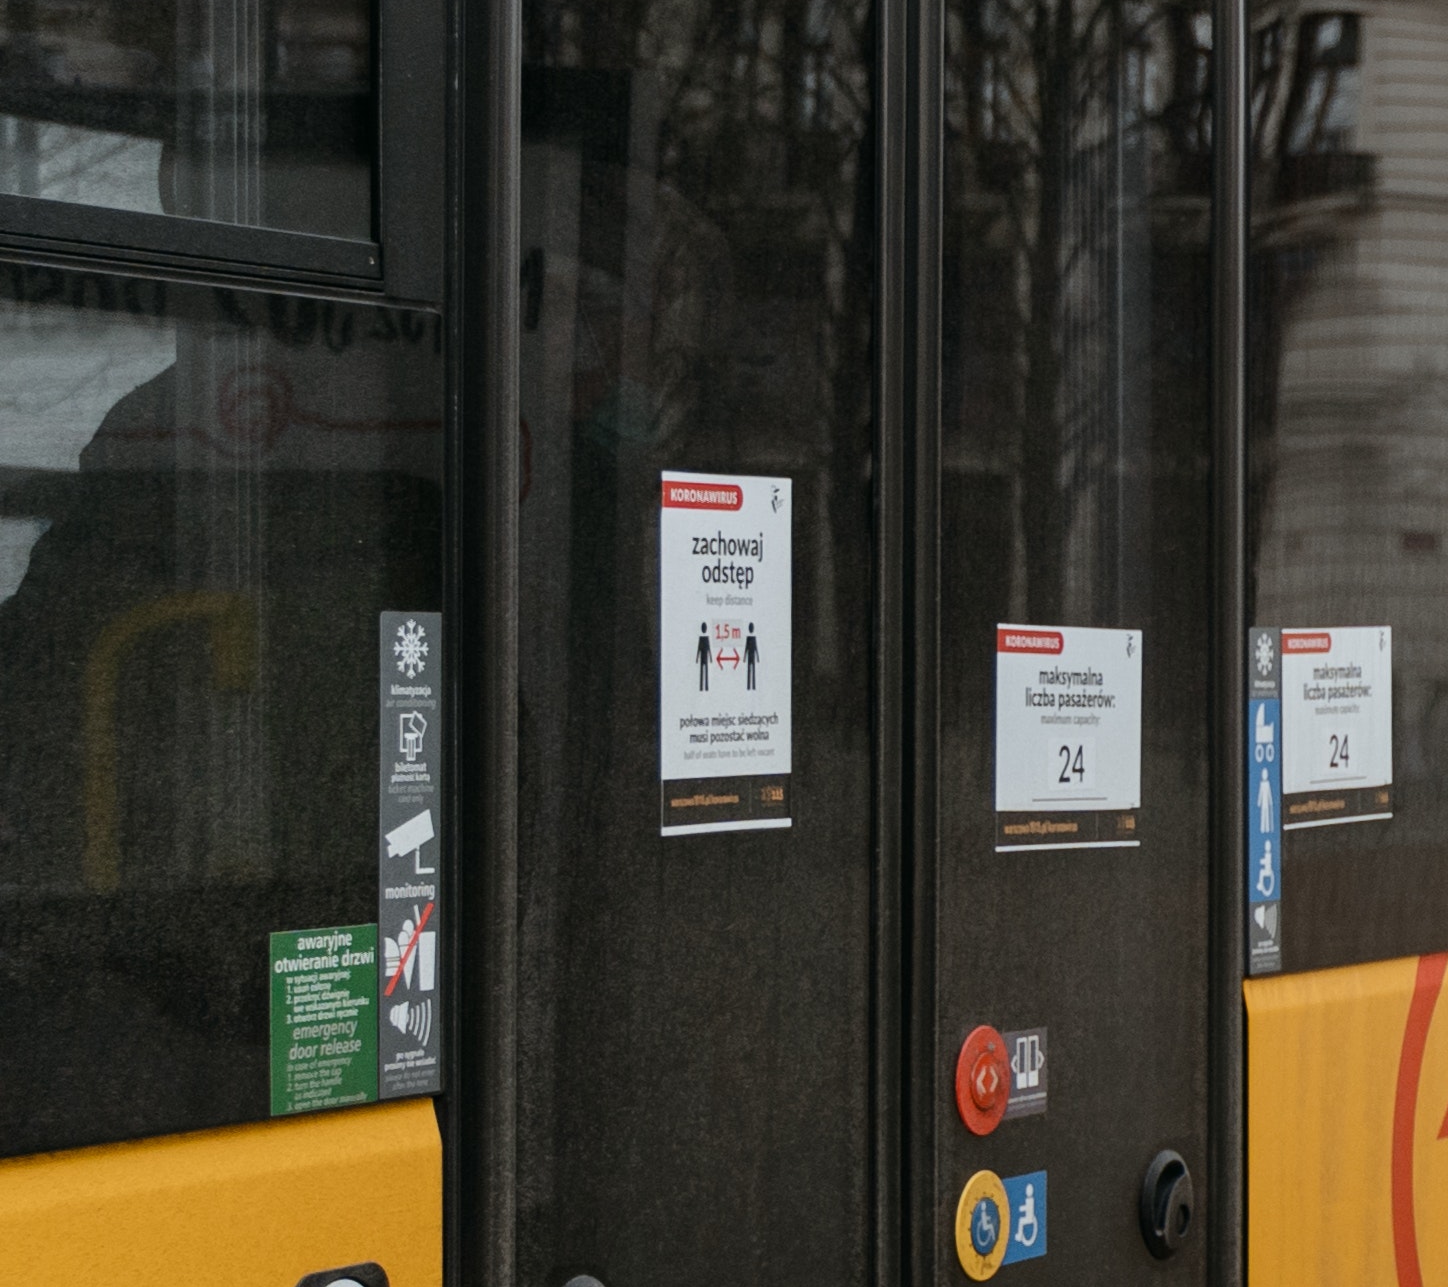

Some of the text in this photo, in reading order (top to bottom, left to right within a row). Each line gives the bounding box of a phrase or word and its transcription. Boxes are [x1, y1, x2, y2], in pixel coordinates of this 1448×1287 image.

[670, 488, 738, 505] KORONAWIRUS
[691, 529, 764, 563] zachowaj
[702, 557, 754, 590] odstęp
[715, 623, 730, 642] 1,5
[1039, 666, 1104, 689] maksymalna
[1025, 687, 1056, 708] liczba
[1329, 734, 1350, 768] 24
[1058, 744, 1085, 783] 24
[385, 882, 435, 900] monitoring
[297, 930, 353, 955] awaryjne
[274, 946, 375, 974] otwieranie drzwi
[293, 1020, 358, 1041] emergency
[289, 1038, 362, 1060] door release
